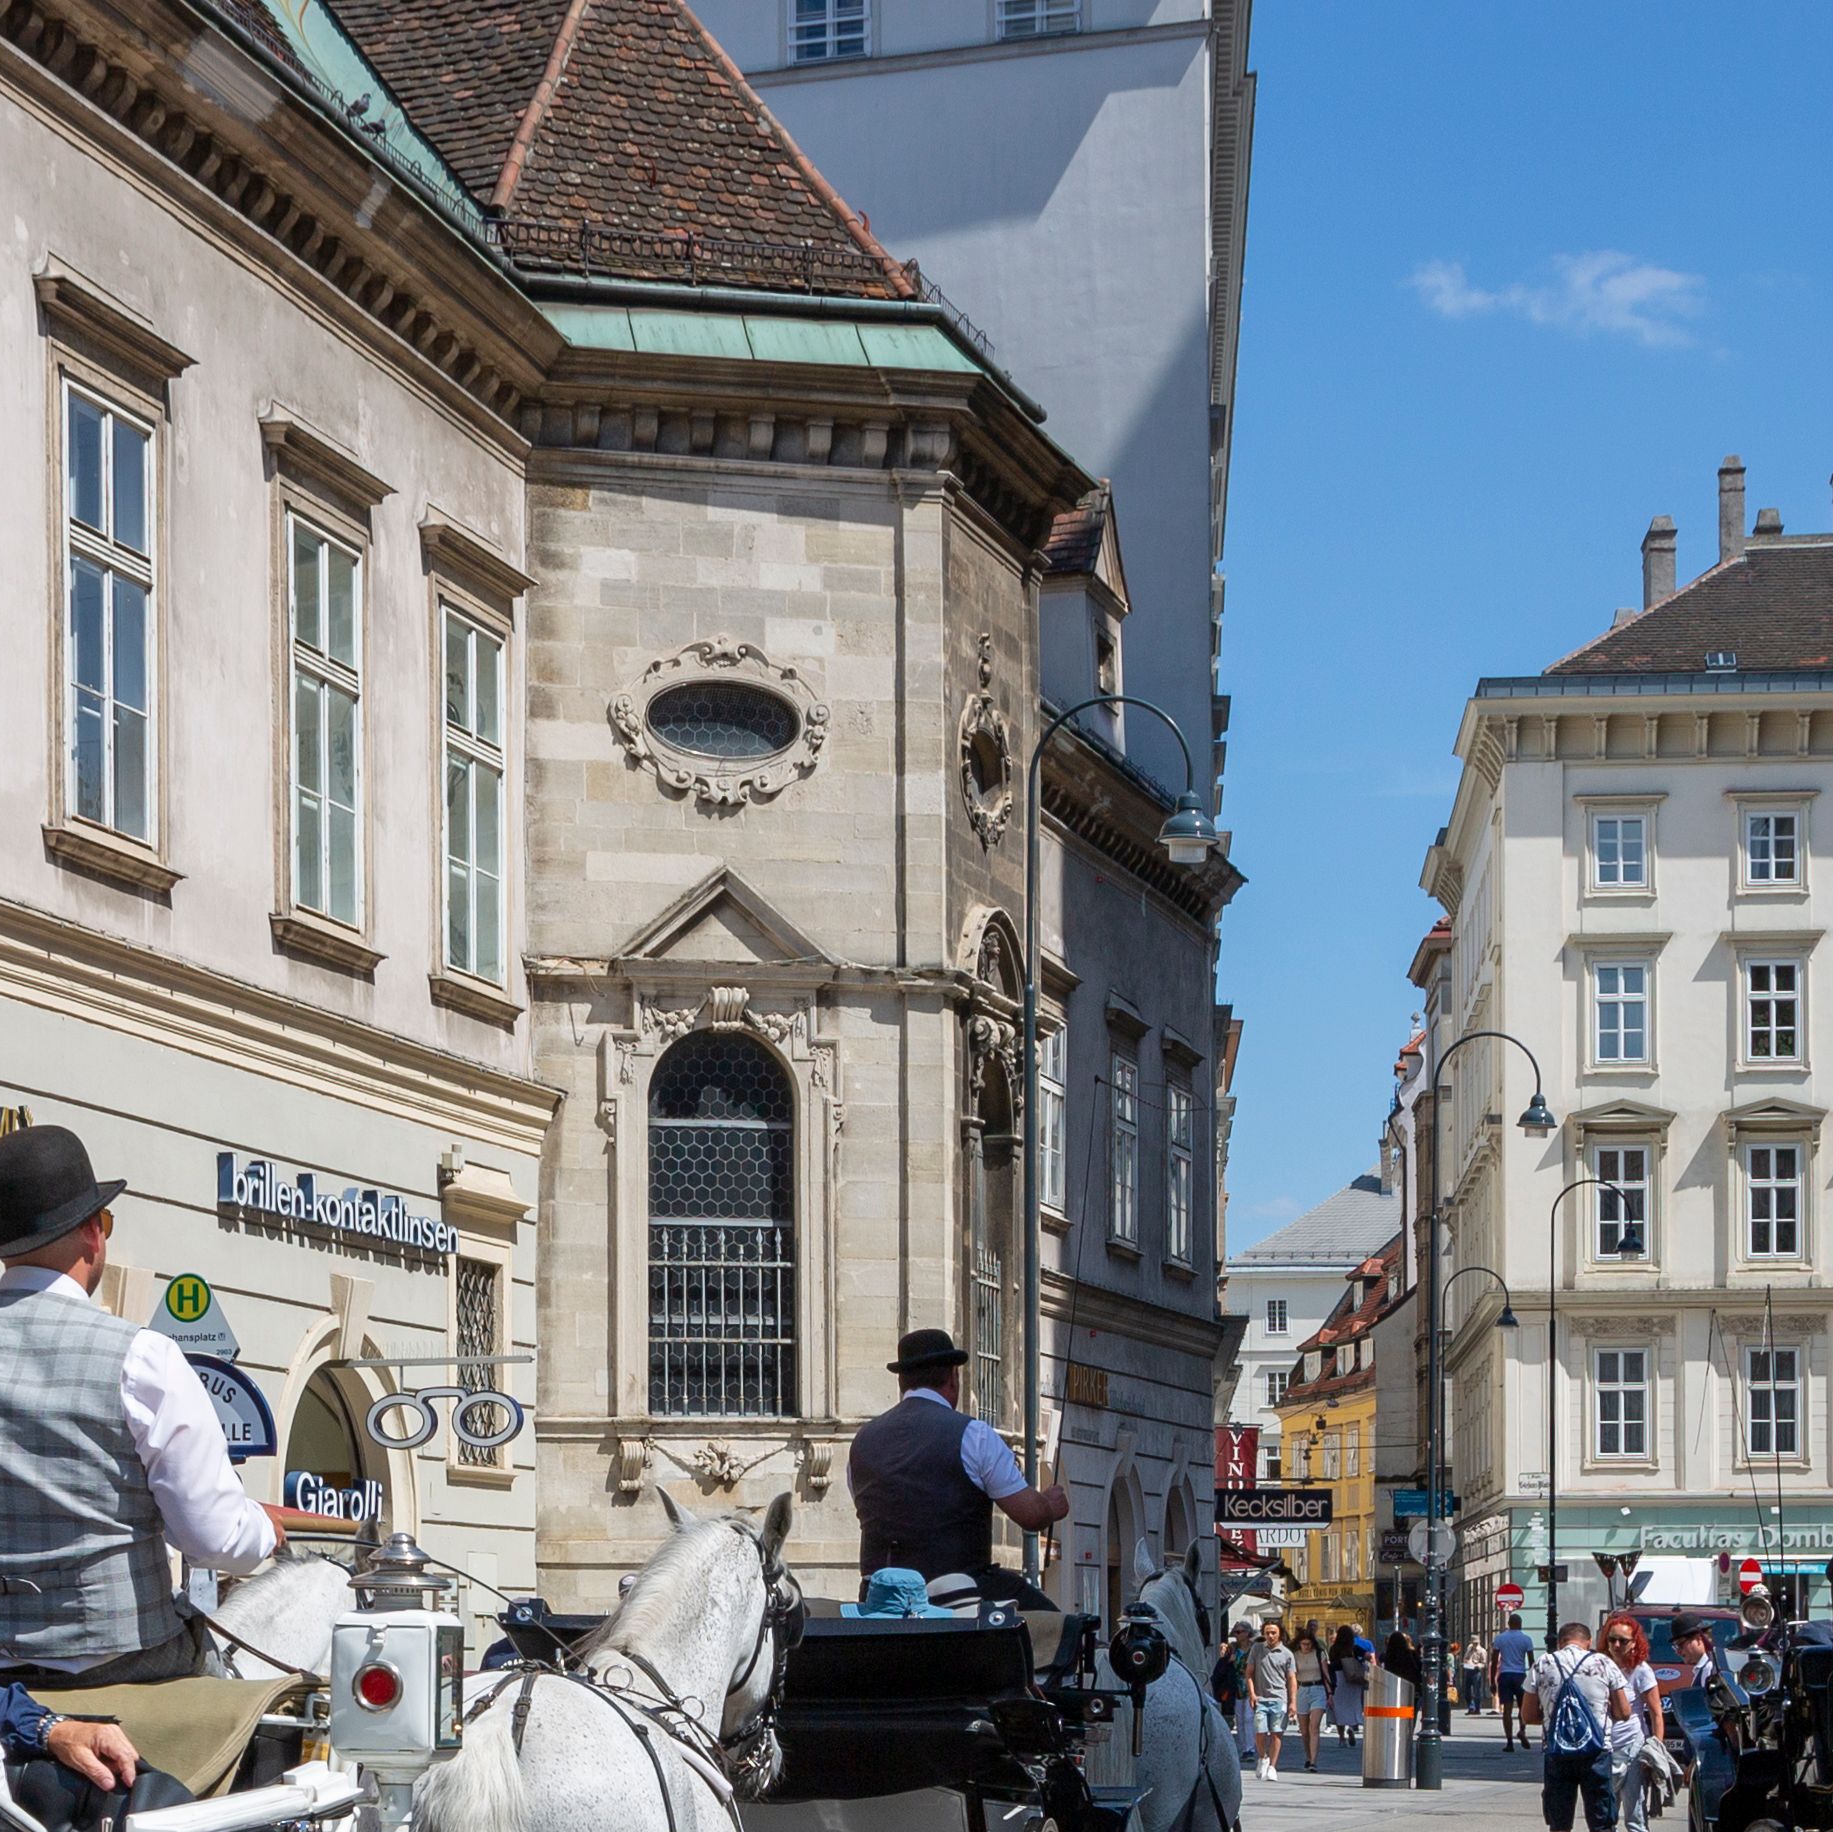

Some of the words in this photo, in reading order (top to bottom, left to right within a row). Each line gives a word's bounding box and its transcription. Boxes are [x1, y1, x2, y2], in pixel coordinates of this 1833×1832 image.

[232, 1160, 460, 1254] brillen-kontaktlinsen
[296, 1471, 383, 1523] Giarolli
[1224, 1494, 1328, 1518] Kecksilber
[1640, 1525, 1743, 1549] Facultas
